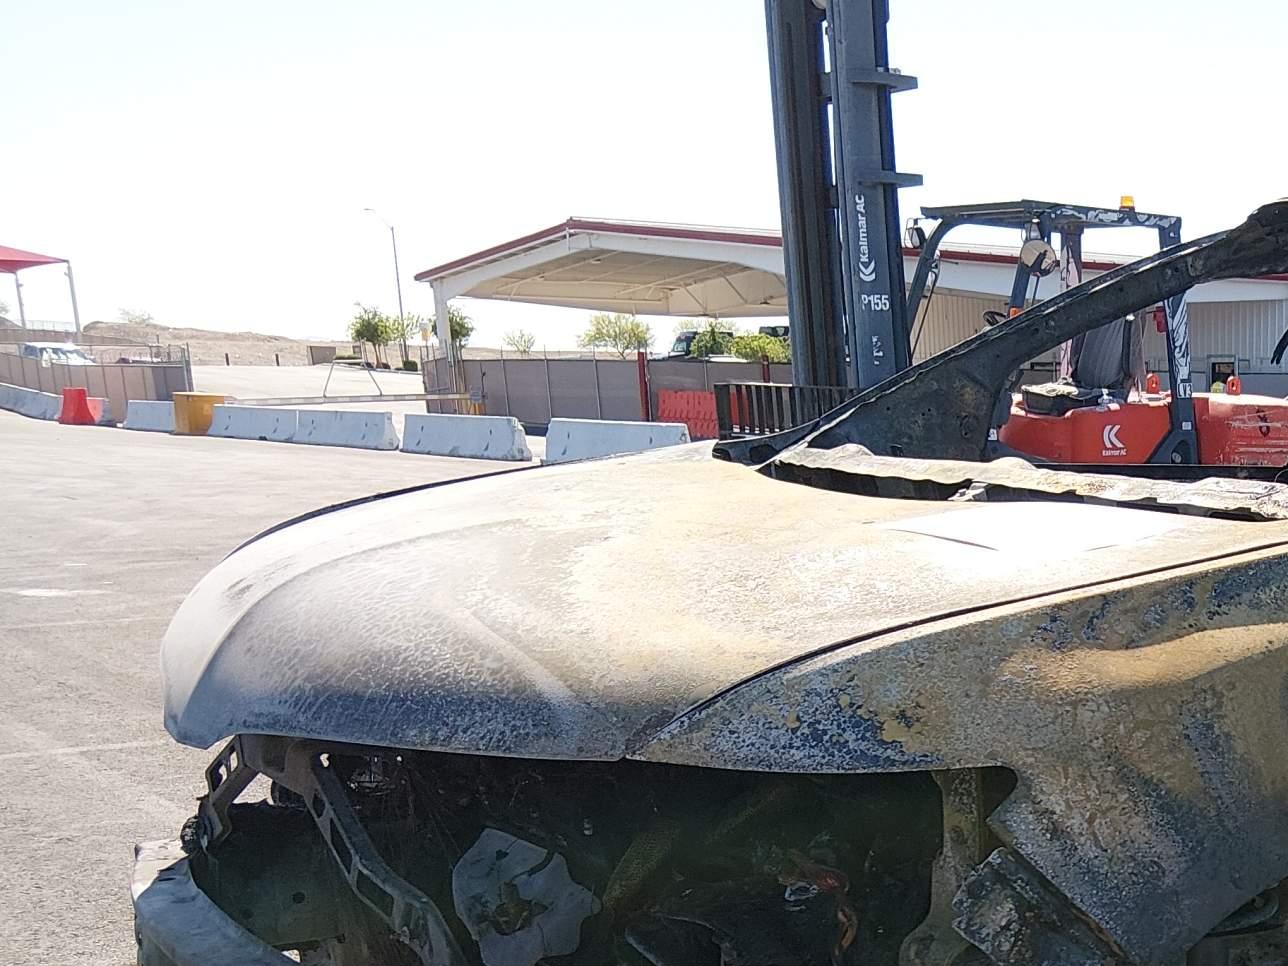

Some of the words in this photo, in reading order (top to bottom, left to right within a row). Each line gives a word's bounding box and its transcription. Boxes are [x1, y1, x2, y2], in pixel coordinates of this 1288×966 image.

[855, 194, 866, 214] AC
[857, 213, 869, 262] Kalmar
[861, 294, 890, 311] P155
